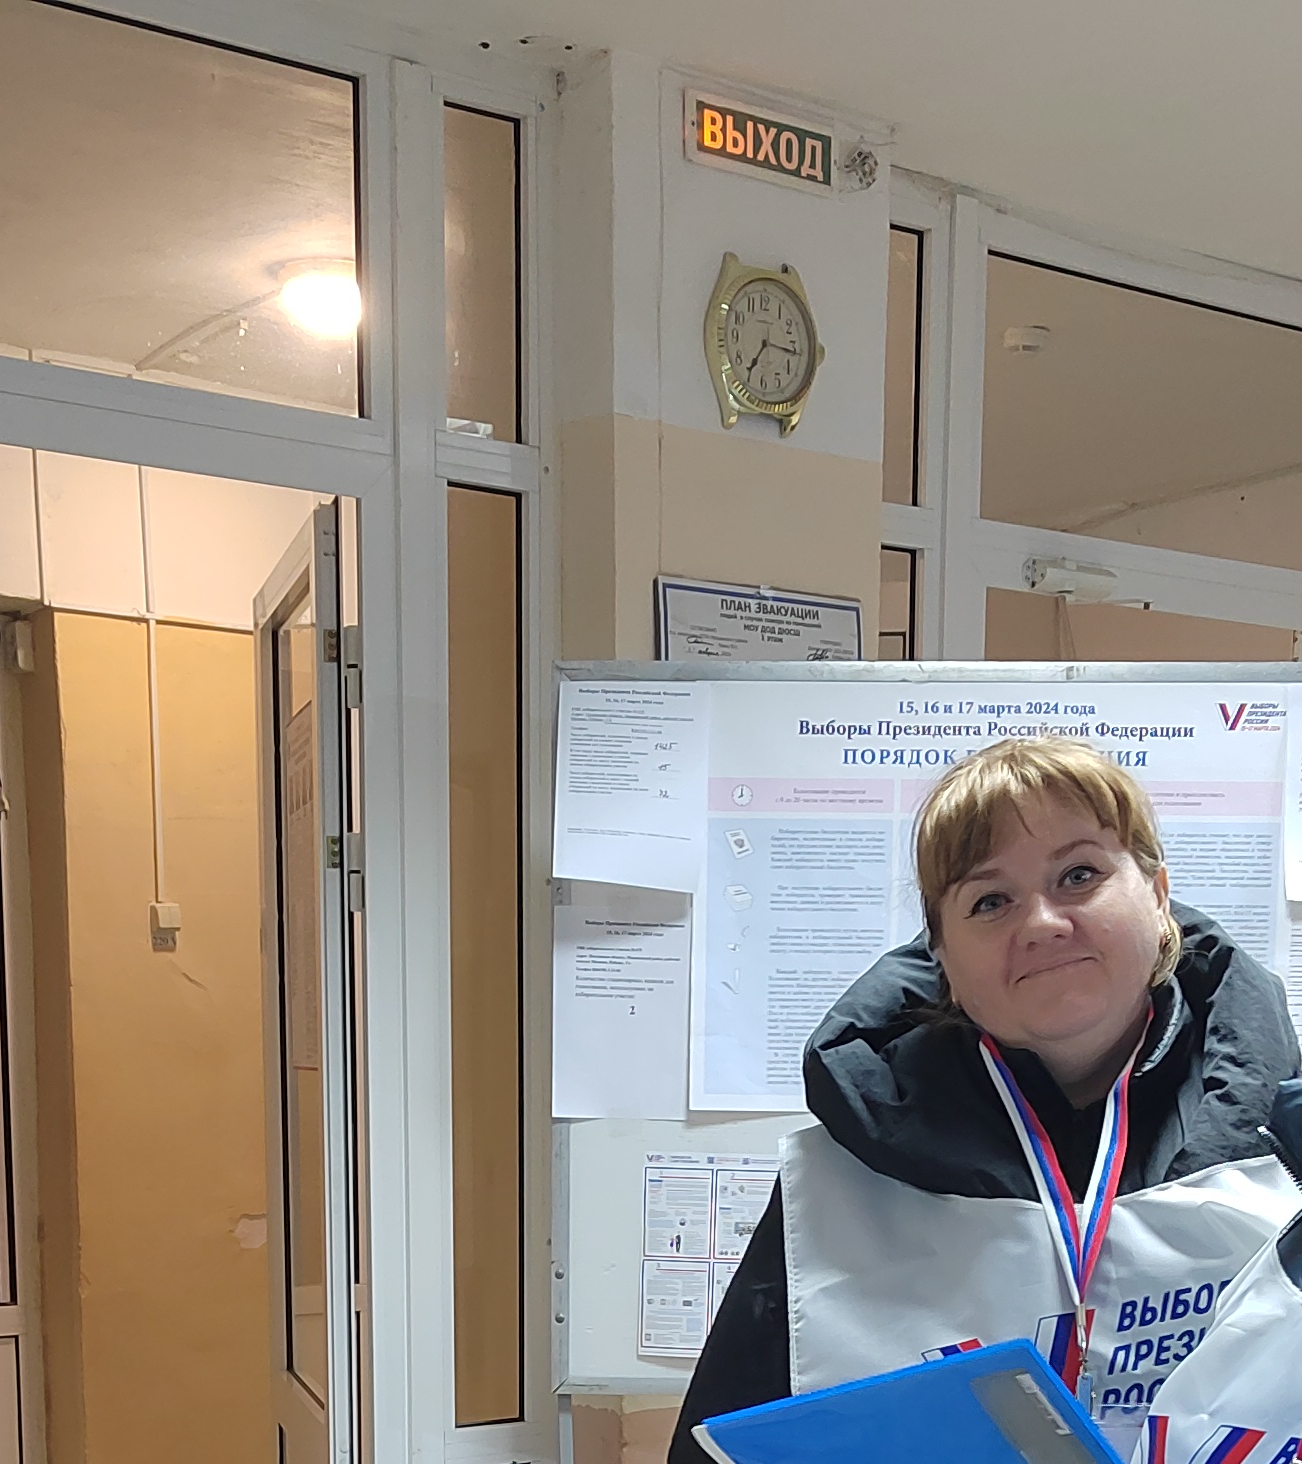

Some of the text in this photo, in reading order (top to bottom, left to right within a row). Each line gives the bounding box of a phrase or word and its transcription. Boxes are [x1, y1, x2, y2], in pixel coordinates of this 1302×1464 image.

[703, 108, 824, 182] ВЫХОД
[760, 294, 770, 311] 12
[734, 310, 745, 326] 10
[777, 303, 782, 320] 1
[785, 319, 793, 335] 2
[731, 328, 739, 345] 9
[735, 351, 743, 366] 8
[760, 375, 768, 391] 6
[774, 372, 781, 389] 5
[720, 599, 820, 621] ПЛАН ЭВАКУАЦИИ
[898, 701, 1096, 719] 15, 16 и 17 марта 2024 года
[798, 720, 1195, 742] Выборы Президента Российской Федерации
[842, 749, 957, 768] ПОРЯДОК
